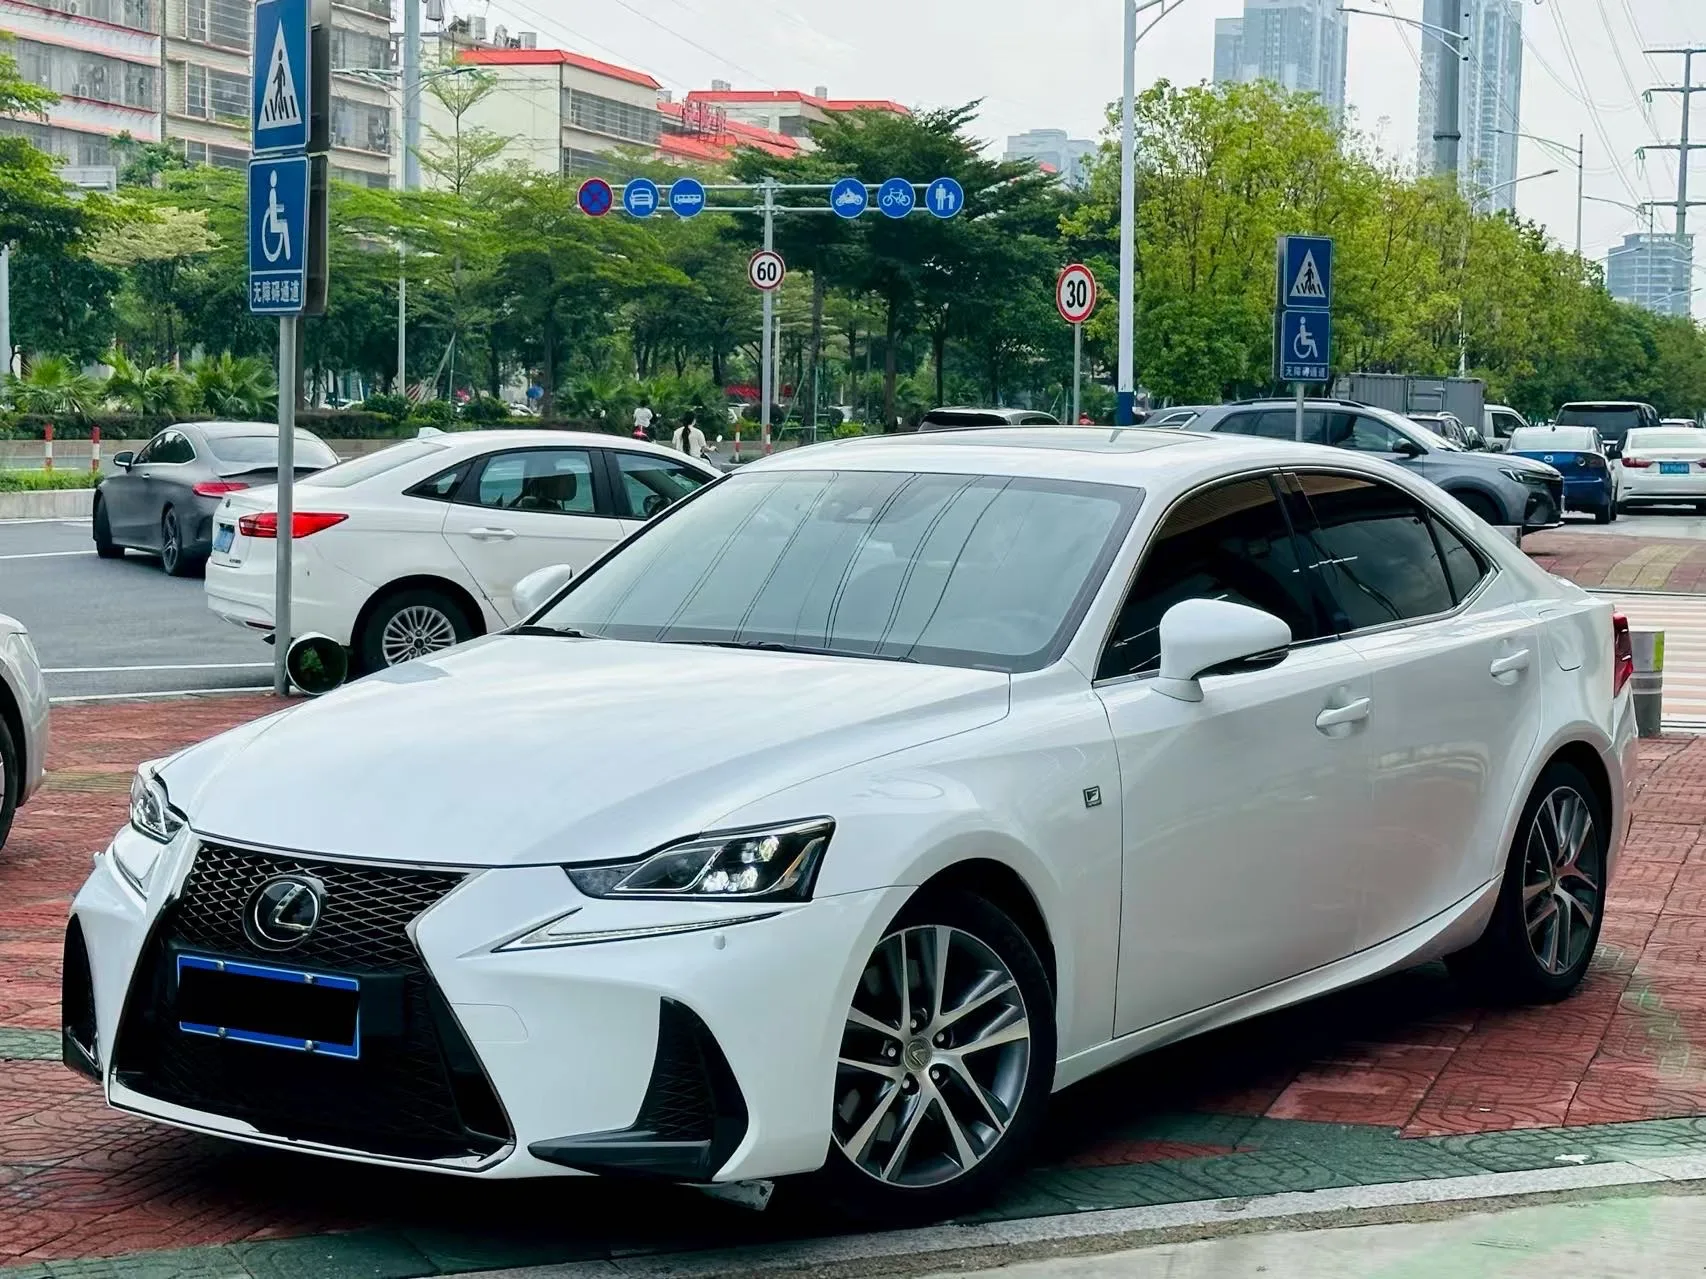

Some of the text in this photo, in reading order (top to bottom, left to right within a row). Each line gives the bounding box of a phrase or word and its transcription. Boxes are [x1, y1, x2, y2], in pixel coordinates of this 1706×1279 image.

[757, 262, 776, 281] 60
[253, 280, 299, 303] 无障碍通道
[1067, 280, 1086, 308] 30
